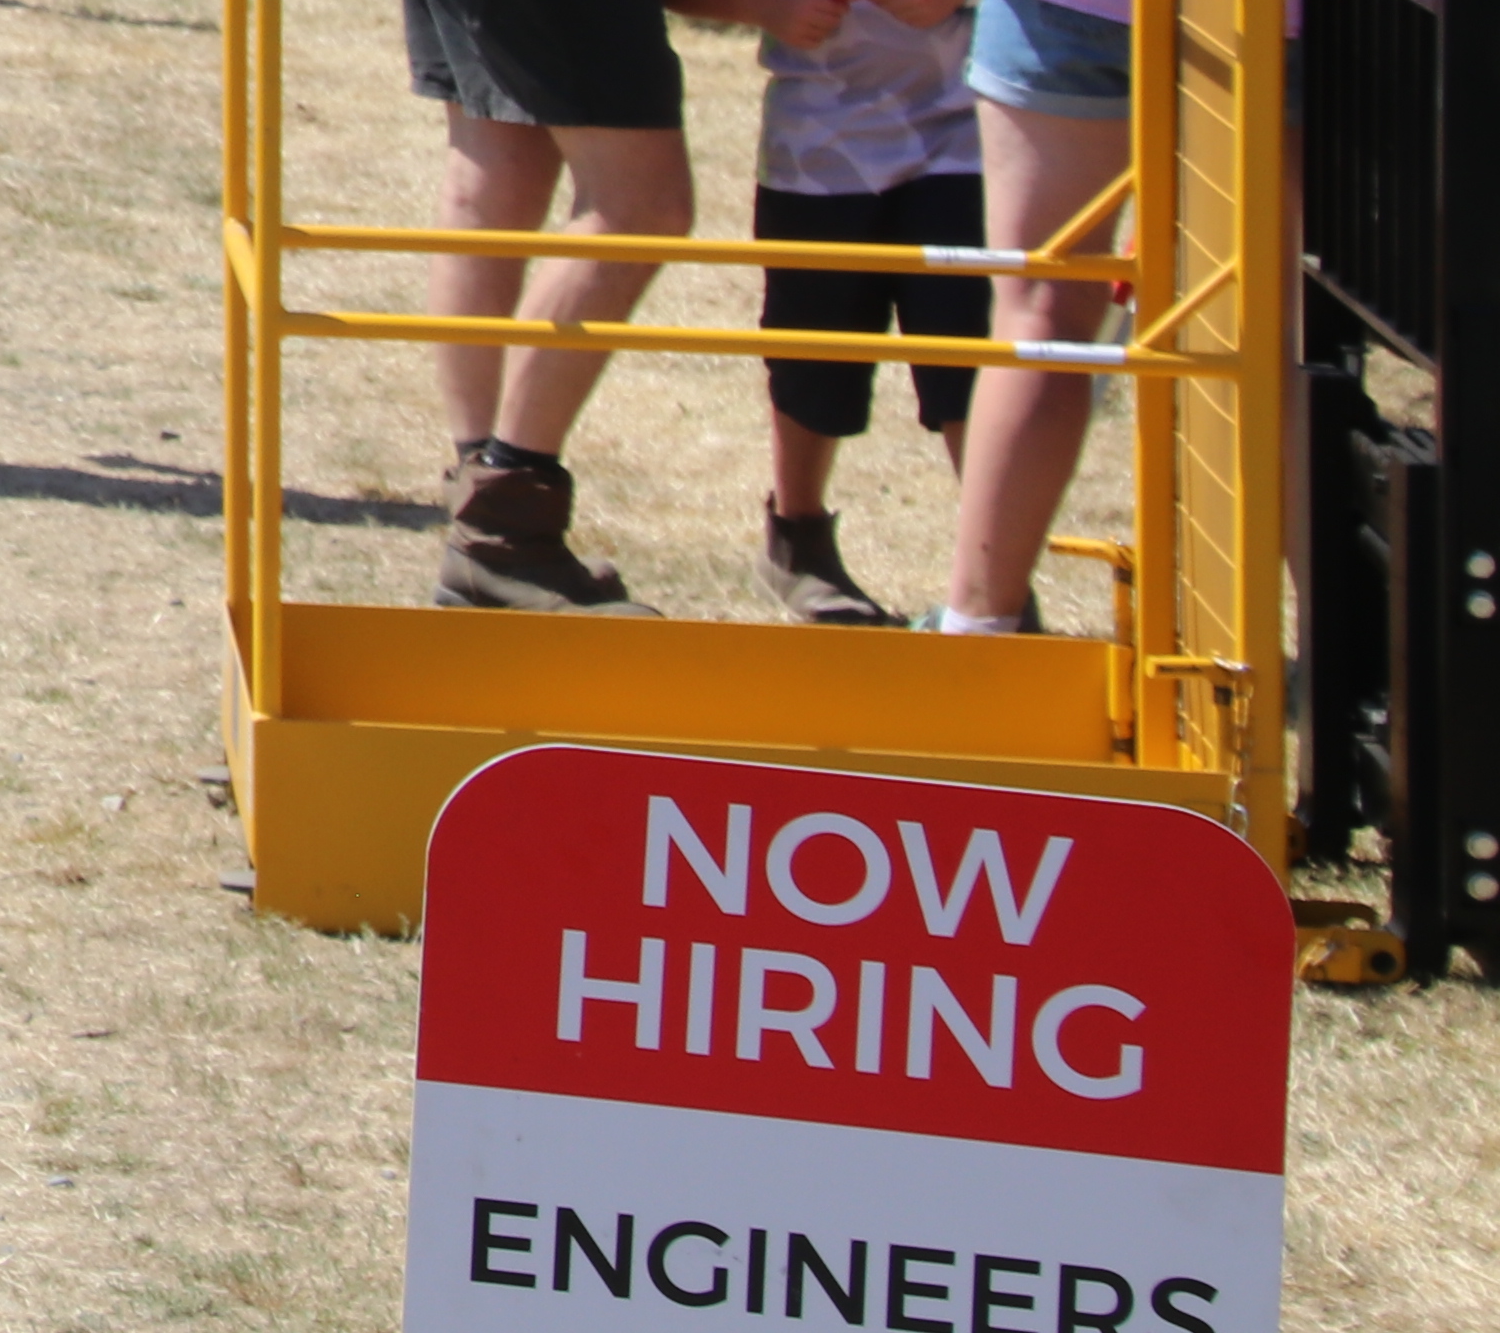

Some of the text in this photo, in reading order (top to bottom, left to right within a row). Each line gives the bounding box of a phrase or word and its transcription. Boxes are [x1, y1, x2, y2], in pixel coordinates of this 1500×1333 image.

[642, 795, 1075, 947] NOW
[556, 928, 1147, 1100] HIRING
[469, 1197, 1221, 1333] ENGINEERS
